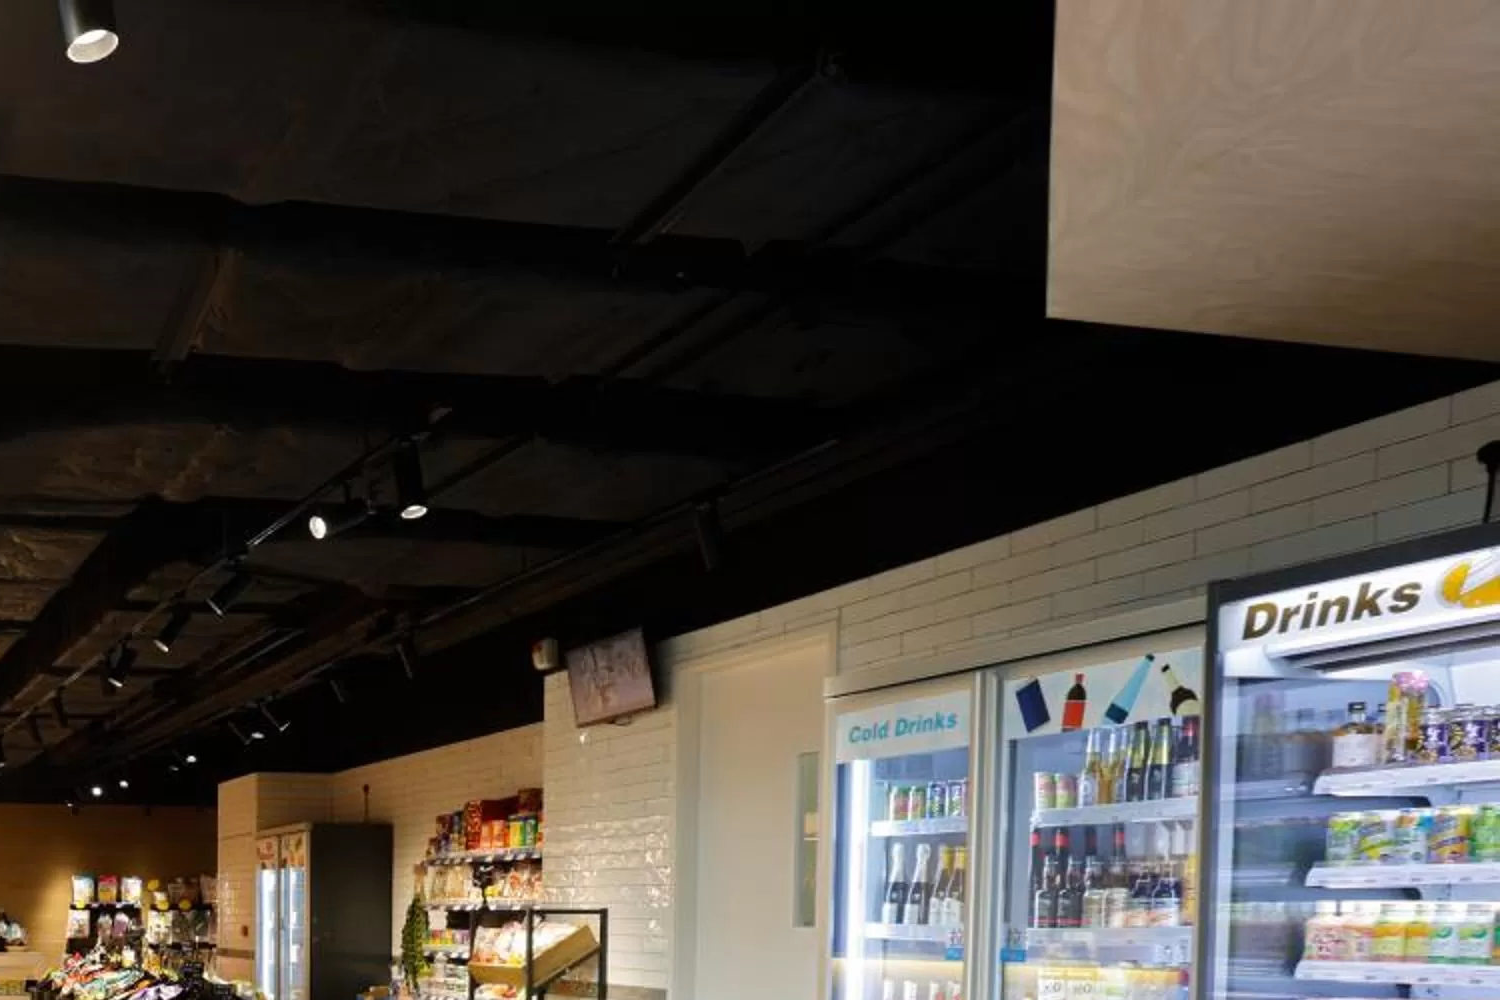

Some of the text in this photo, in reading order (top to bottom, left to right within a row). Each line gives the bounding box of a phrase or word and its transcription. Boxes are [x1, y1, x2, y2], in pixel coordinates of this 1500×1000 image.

[1242, 581, 1423, 642] Drinks
[848, 711, 958, 744] Cold Drinks
